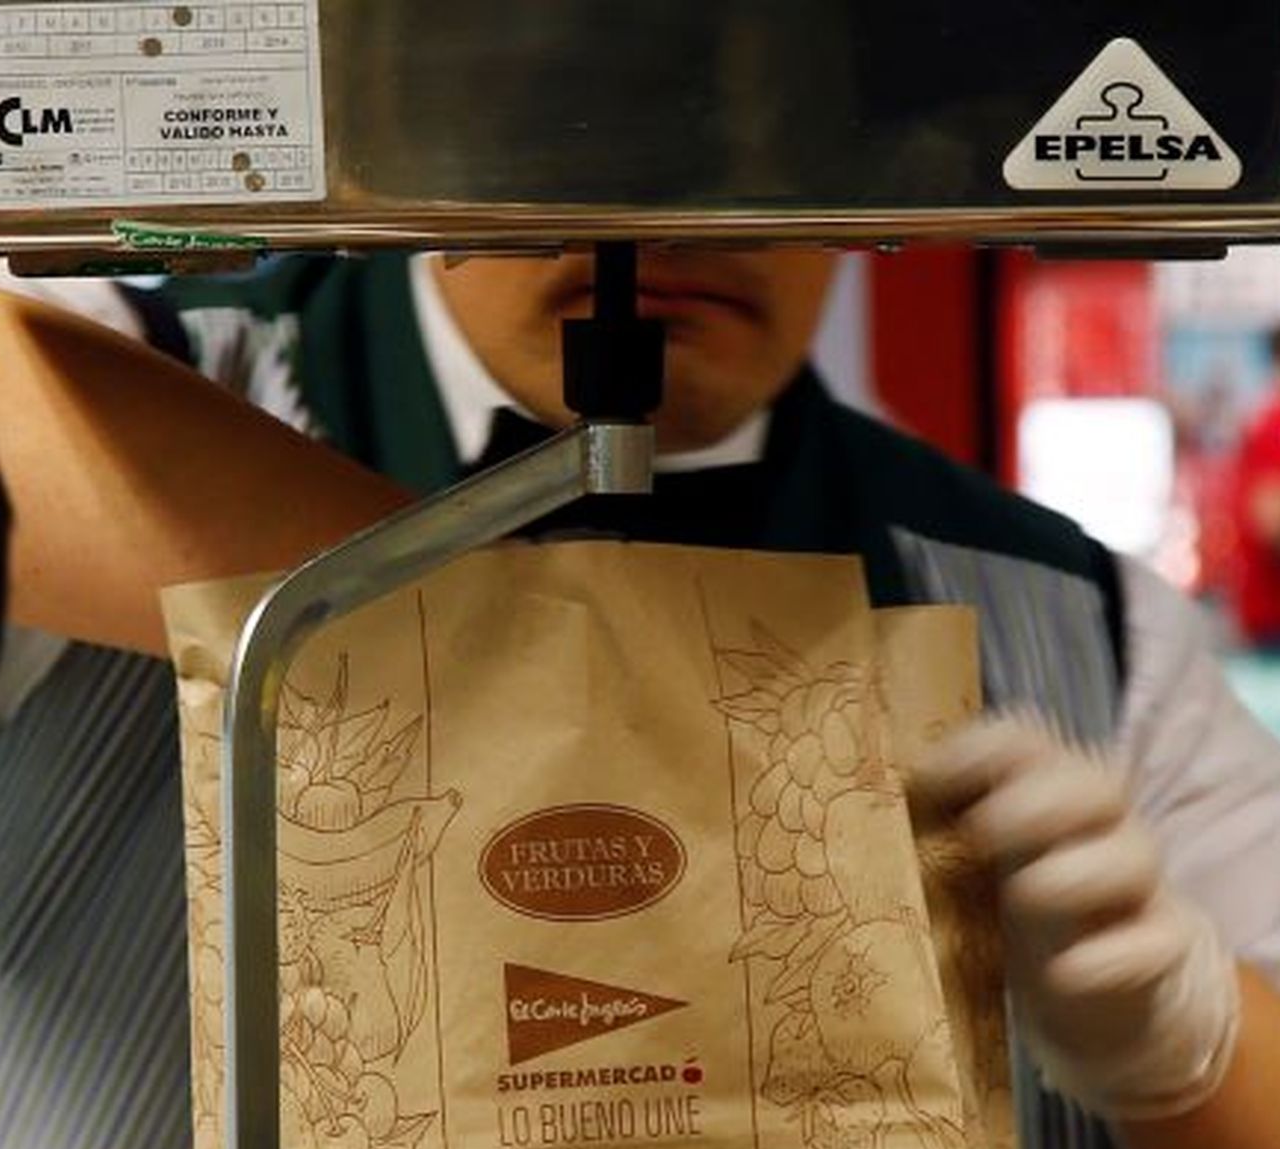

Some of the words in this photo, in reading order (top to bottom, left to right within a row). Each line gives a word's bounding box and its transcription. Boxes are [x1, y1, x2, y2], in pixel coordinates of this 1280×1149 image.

[164, 107, 263, 123] CONFORME
[266, 107, 279, 120] Y
[161, 125, 224, 140] VALIDO
[228, 123, 289, 138] HASTA
[1034, 134, 1221, 161] EPELSA
[509, 836, 624, 866] FRUTAS
[633, 834, 655, 858] Y
[499, 861, 666, 893] VERDURAS
[496, 1104, 532, 1148] LO
[540, 1098, 637, 1146] BUENO
[644, 1094, 704, 1140] UNE
